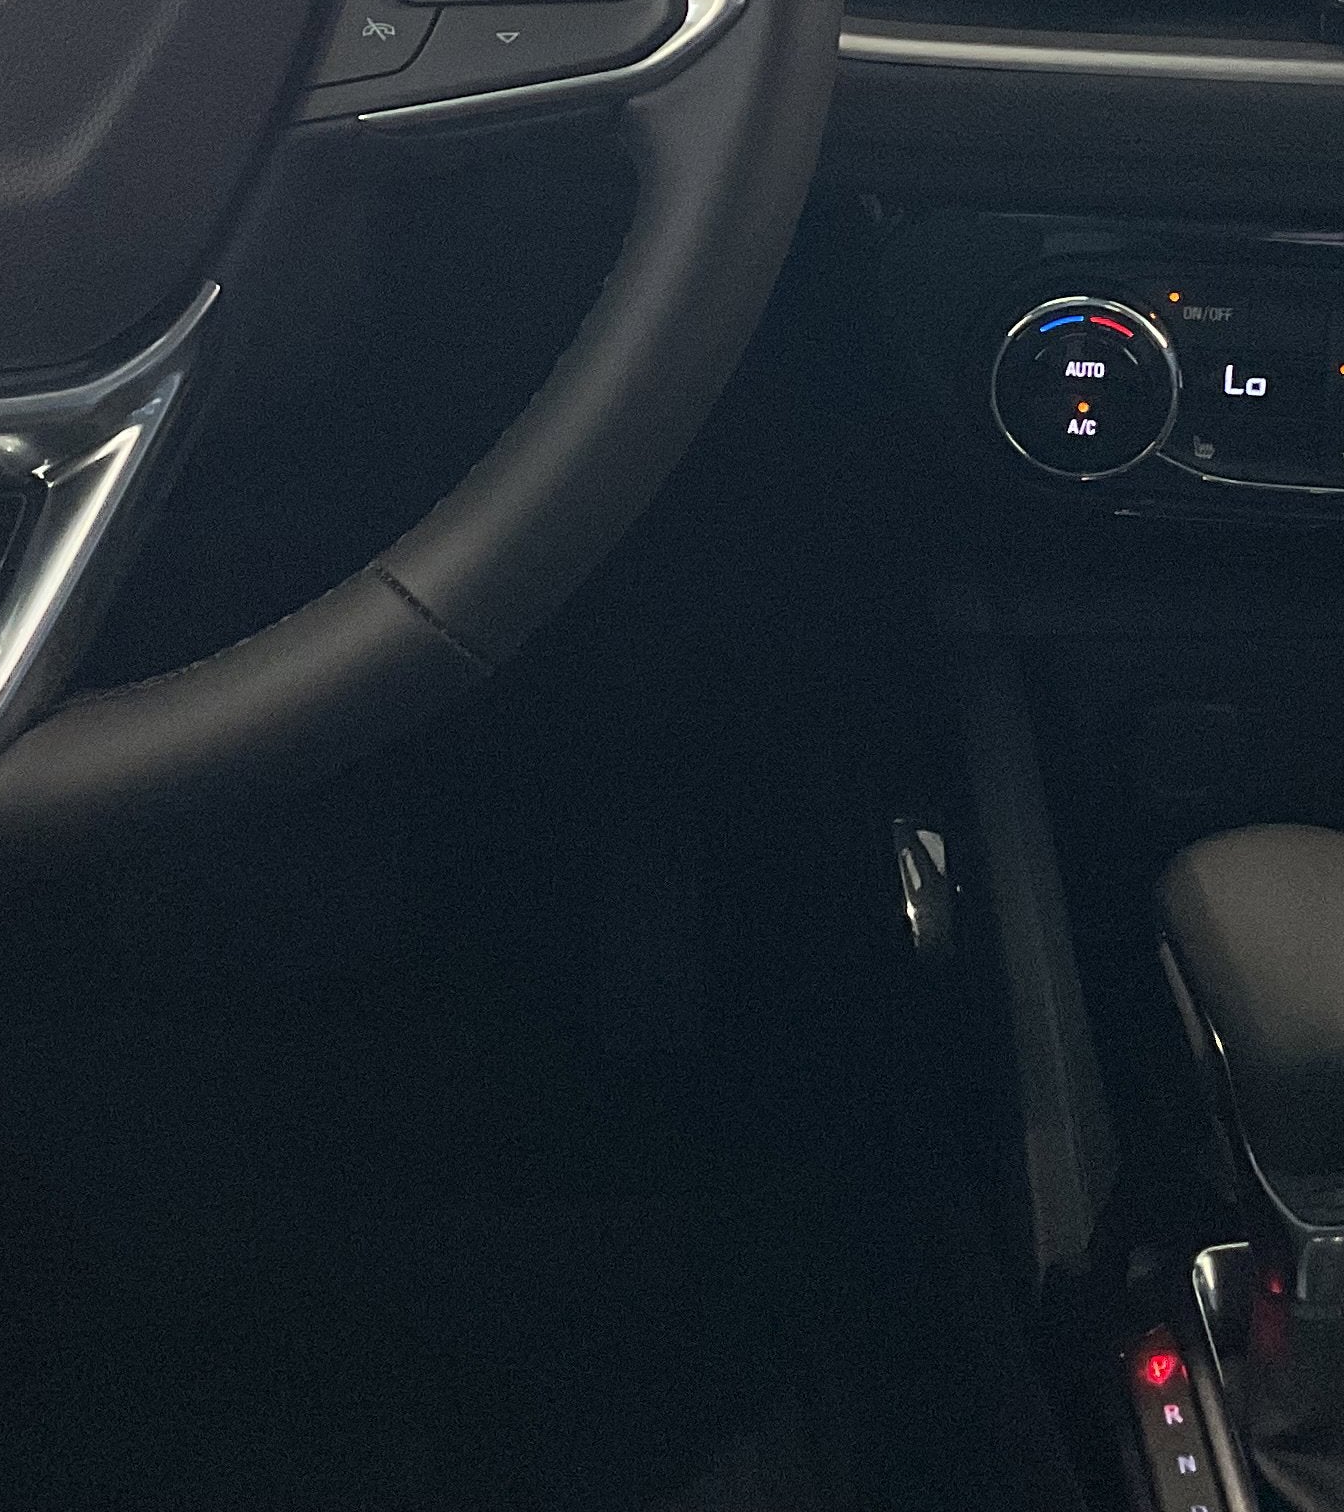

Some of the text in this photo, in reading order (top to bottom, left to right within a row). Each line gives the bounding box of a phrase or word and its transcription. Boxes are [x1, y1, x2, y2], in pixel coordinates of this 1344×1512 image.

[1182, 306, 1234, 322] ON/OFF
[1065, 360, 1105, 379] AUTO
[1067, 419, 1097, 437] A/C
[1163, 1404, 1184, 1425] R
[1178, 1455, 1197, 1474] N
